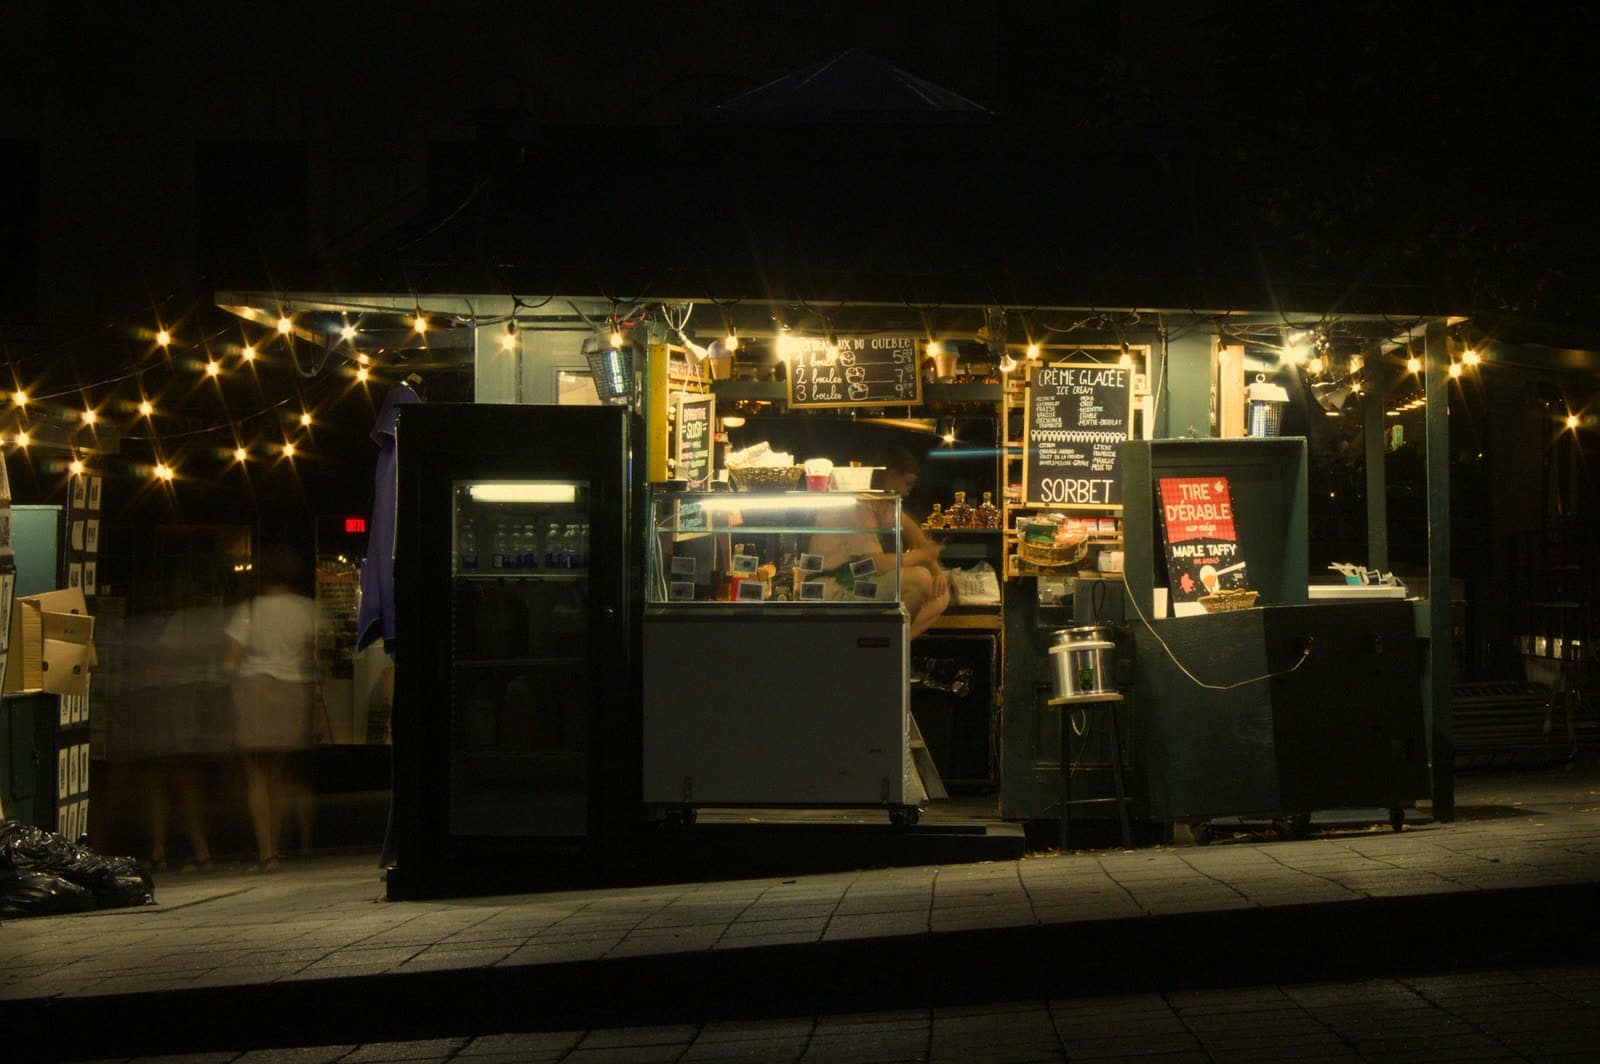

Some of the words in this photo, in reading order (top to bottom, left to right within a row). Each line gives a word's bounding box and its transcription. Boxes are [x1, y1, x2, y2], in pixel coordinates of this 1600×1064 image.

[795, 367, 808, 385] 2
[1038, 368, 1075, 386] CRÈME
[1079, 368, 1125, 388] GLACÉE
[795, 384, 807, 401] 3
[1056, 386, 1070, 395] ICE
[1072, 386, 1094, 395] CREAM
[1041, 478, 1114, 504] SORBET
[1178, 483, 1211, 500] TIRE
[1166, 500, 1231, 521] D'ÉRABLE
[1172, 545, 1205, 558] MAPLE
[1206, 543, 1237, 556] TAFFY
